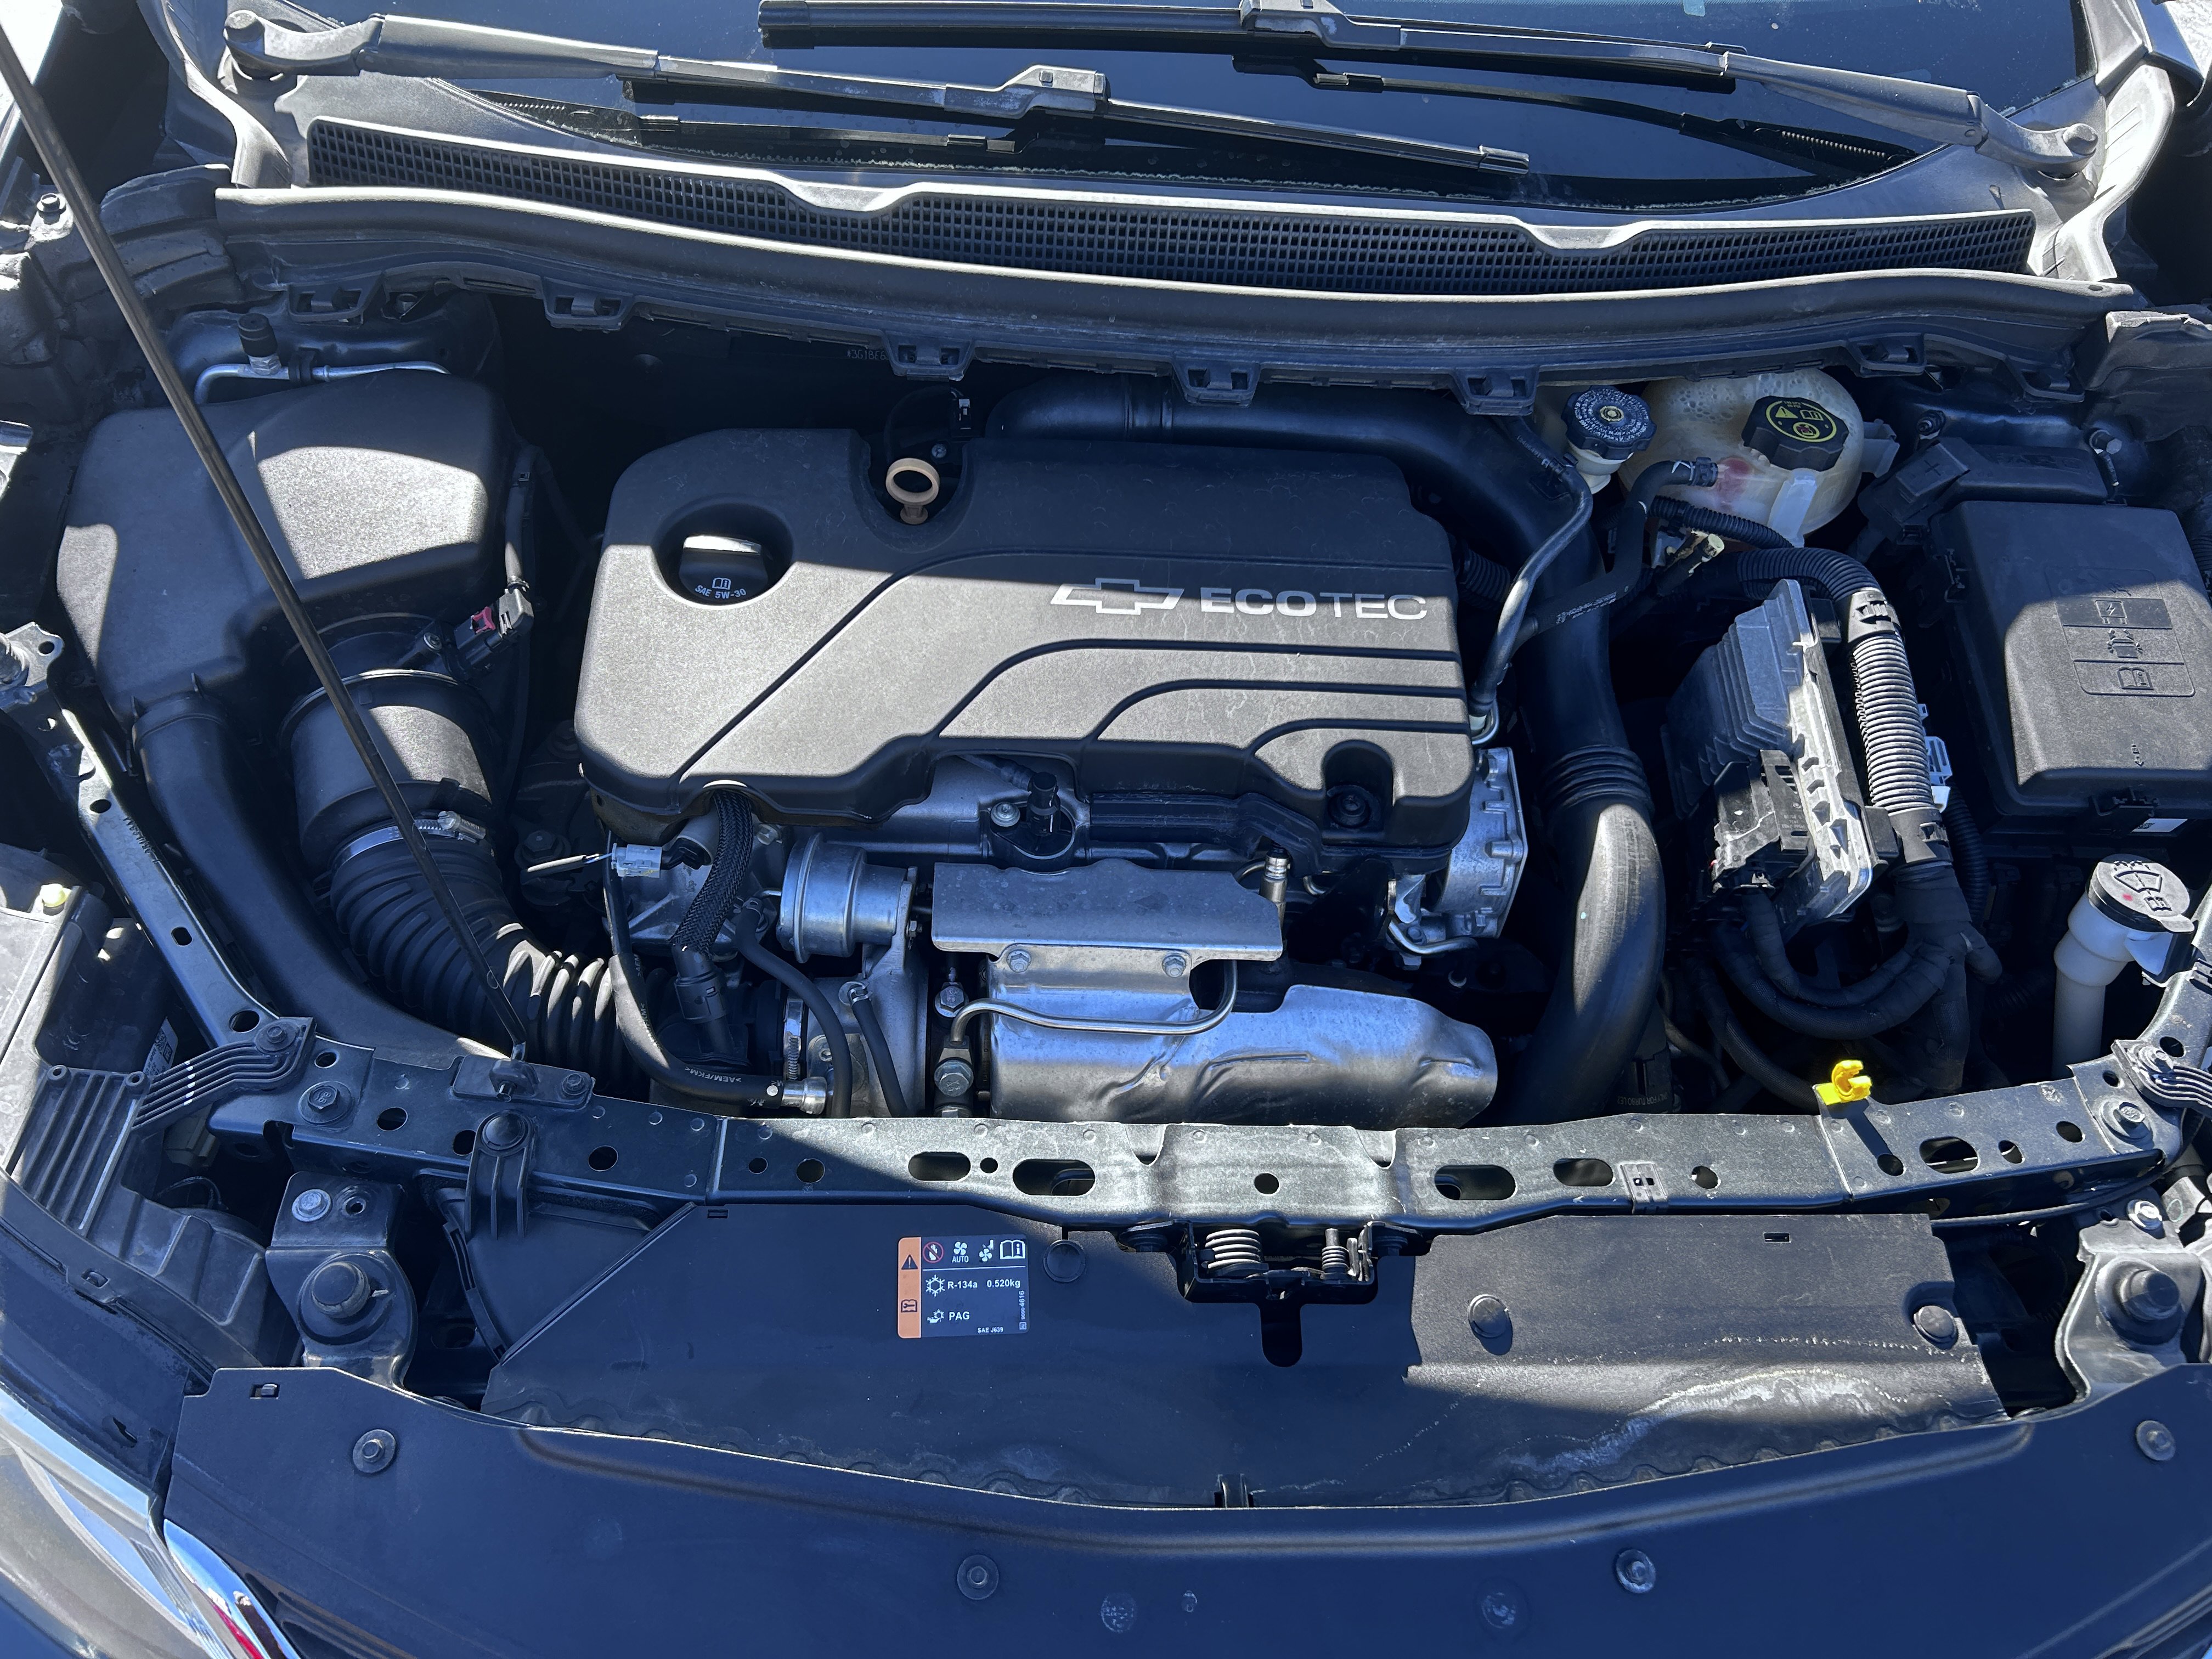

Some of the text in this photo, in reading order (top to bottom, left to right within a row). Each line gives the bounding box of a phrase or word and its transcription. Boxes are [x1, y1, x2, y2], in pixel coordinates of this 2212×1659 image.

[695, 584, 747, 599] SAE 5W-30
[1200, 586, 1427, 620] ECOTEC
[1627, 1097, 1646, 1105] TURBO
[952, 1255, 969, 1263] AUTO
[947, 1279, 1020, 1289] R-134a 0.520kg
[949, 1311, 970, 1321] PAG
